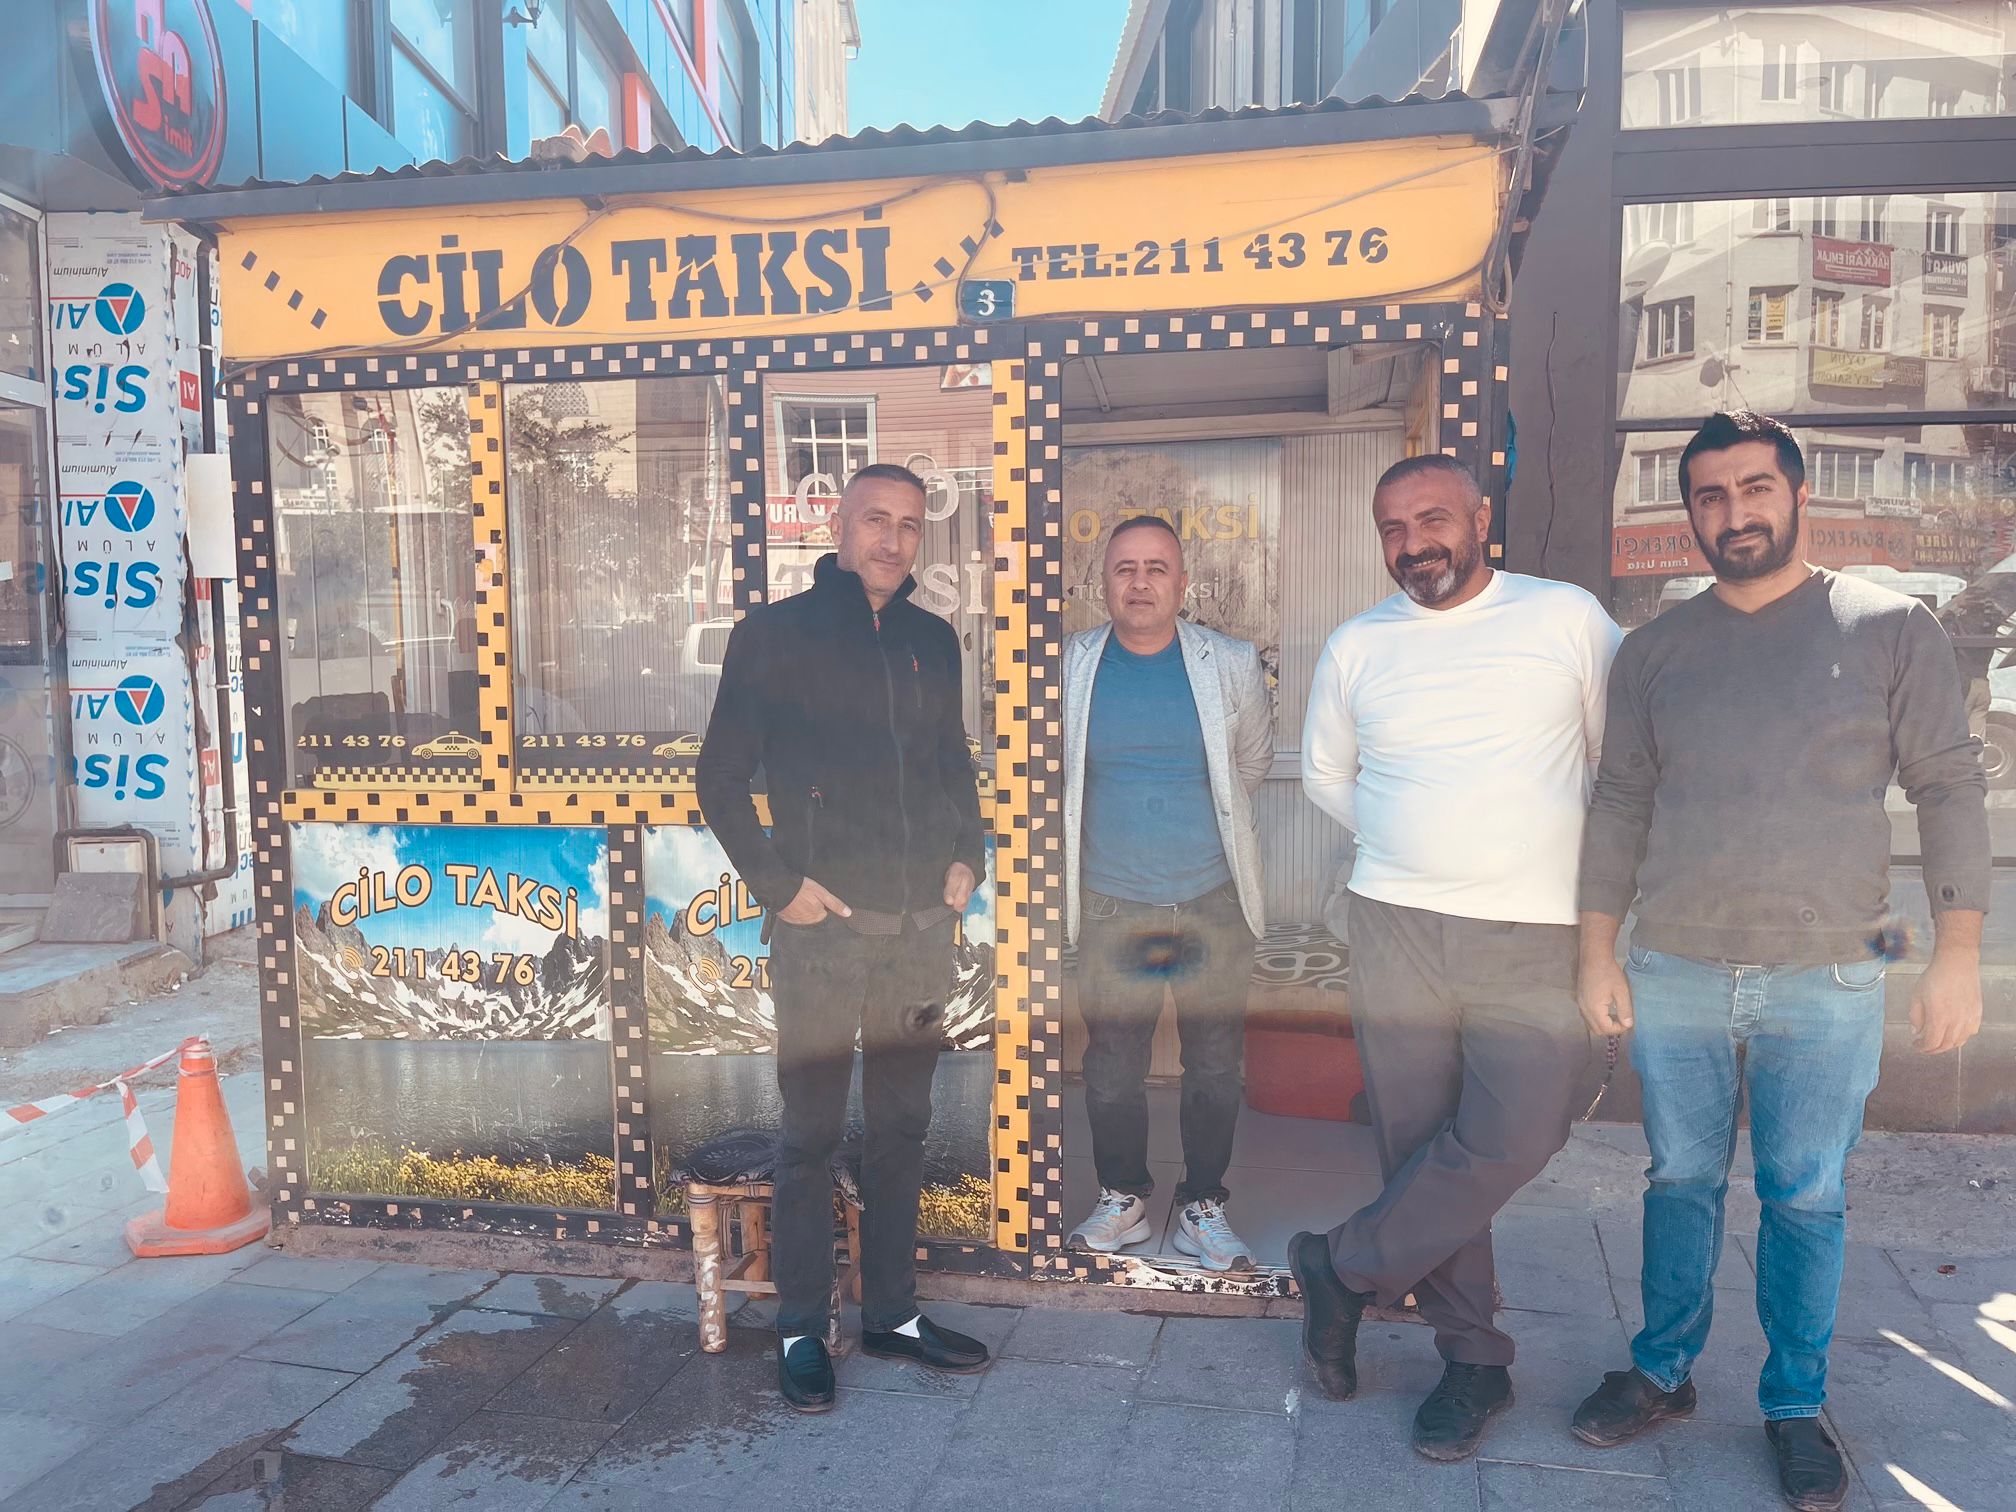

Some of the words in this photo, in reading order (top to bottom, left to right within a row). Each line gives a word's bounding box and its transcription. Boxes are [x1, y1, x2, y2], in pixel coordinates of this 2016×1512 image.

[1244, 231, 1306, 270] 43
[1325, 226, 1389, 266] 76
[53, 267, 108, 277] Aluminium
[377, 233, 592, 336] CİLO
[611, 206, 893, 321] TAKSİ
[977, 288, 995, 317] 3
[62, 464, 118, 475] Aluminium
[60, 500, 100, 527] Al
[72, 660, 128, 670] Aluminium
[70, 694, 110, 720] Al
[342, 735, 370, 747] 43
[378, 735, 406, 748] 76
[522, 735, 565, 748] 211
[575, 735, 607, 747] 43
[616, 734, 646, 747] 76
[330, 864, 432, 927] CİLO
[445, 864, 579, 940] TAKSİ
[686, 873, 764, 938] CİL
[371, 945, 426, 978] 211
[441, 950, 481, 983] 43
[492, 952, 535, 986] 76
[731, 960, 772, 989] 21
